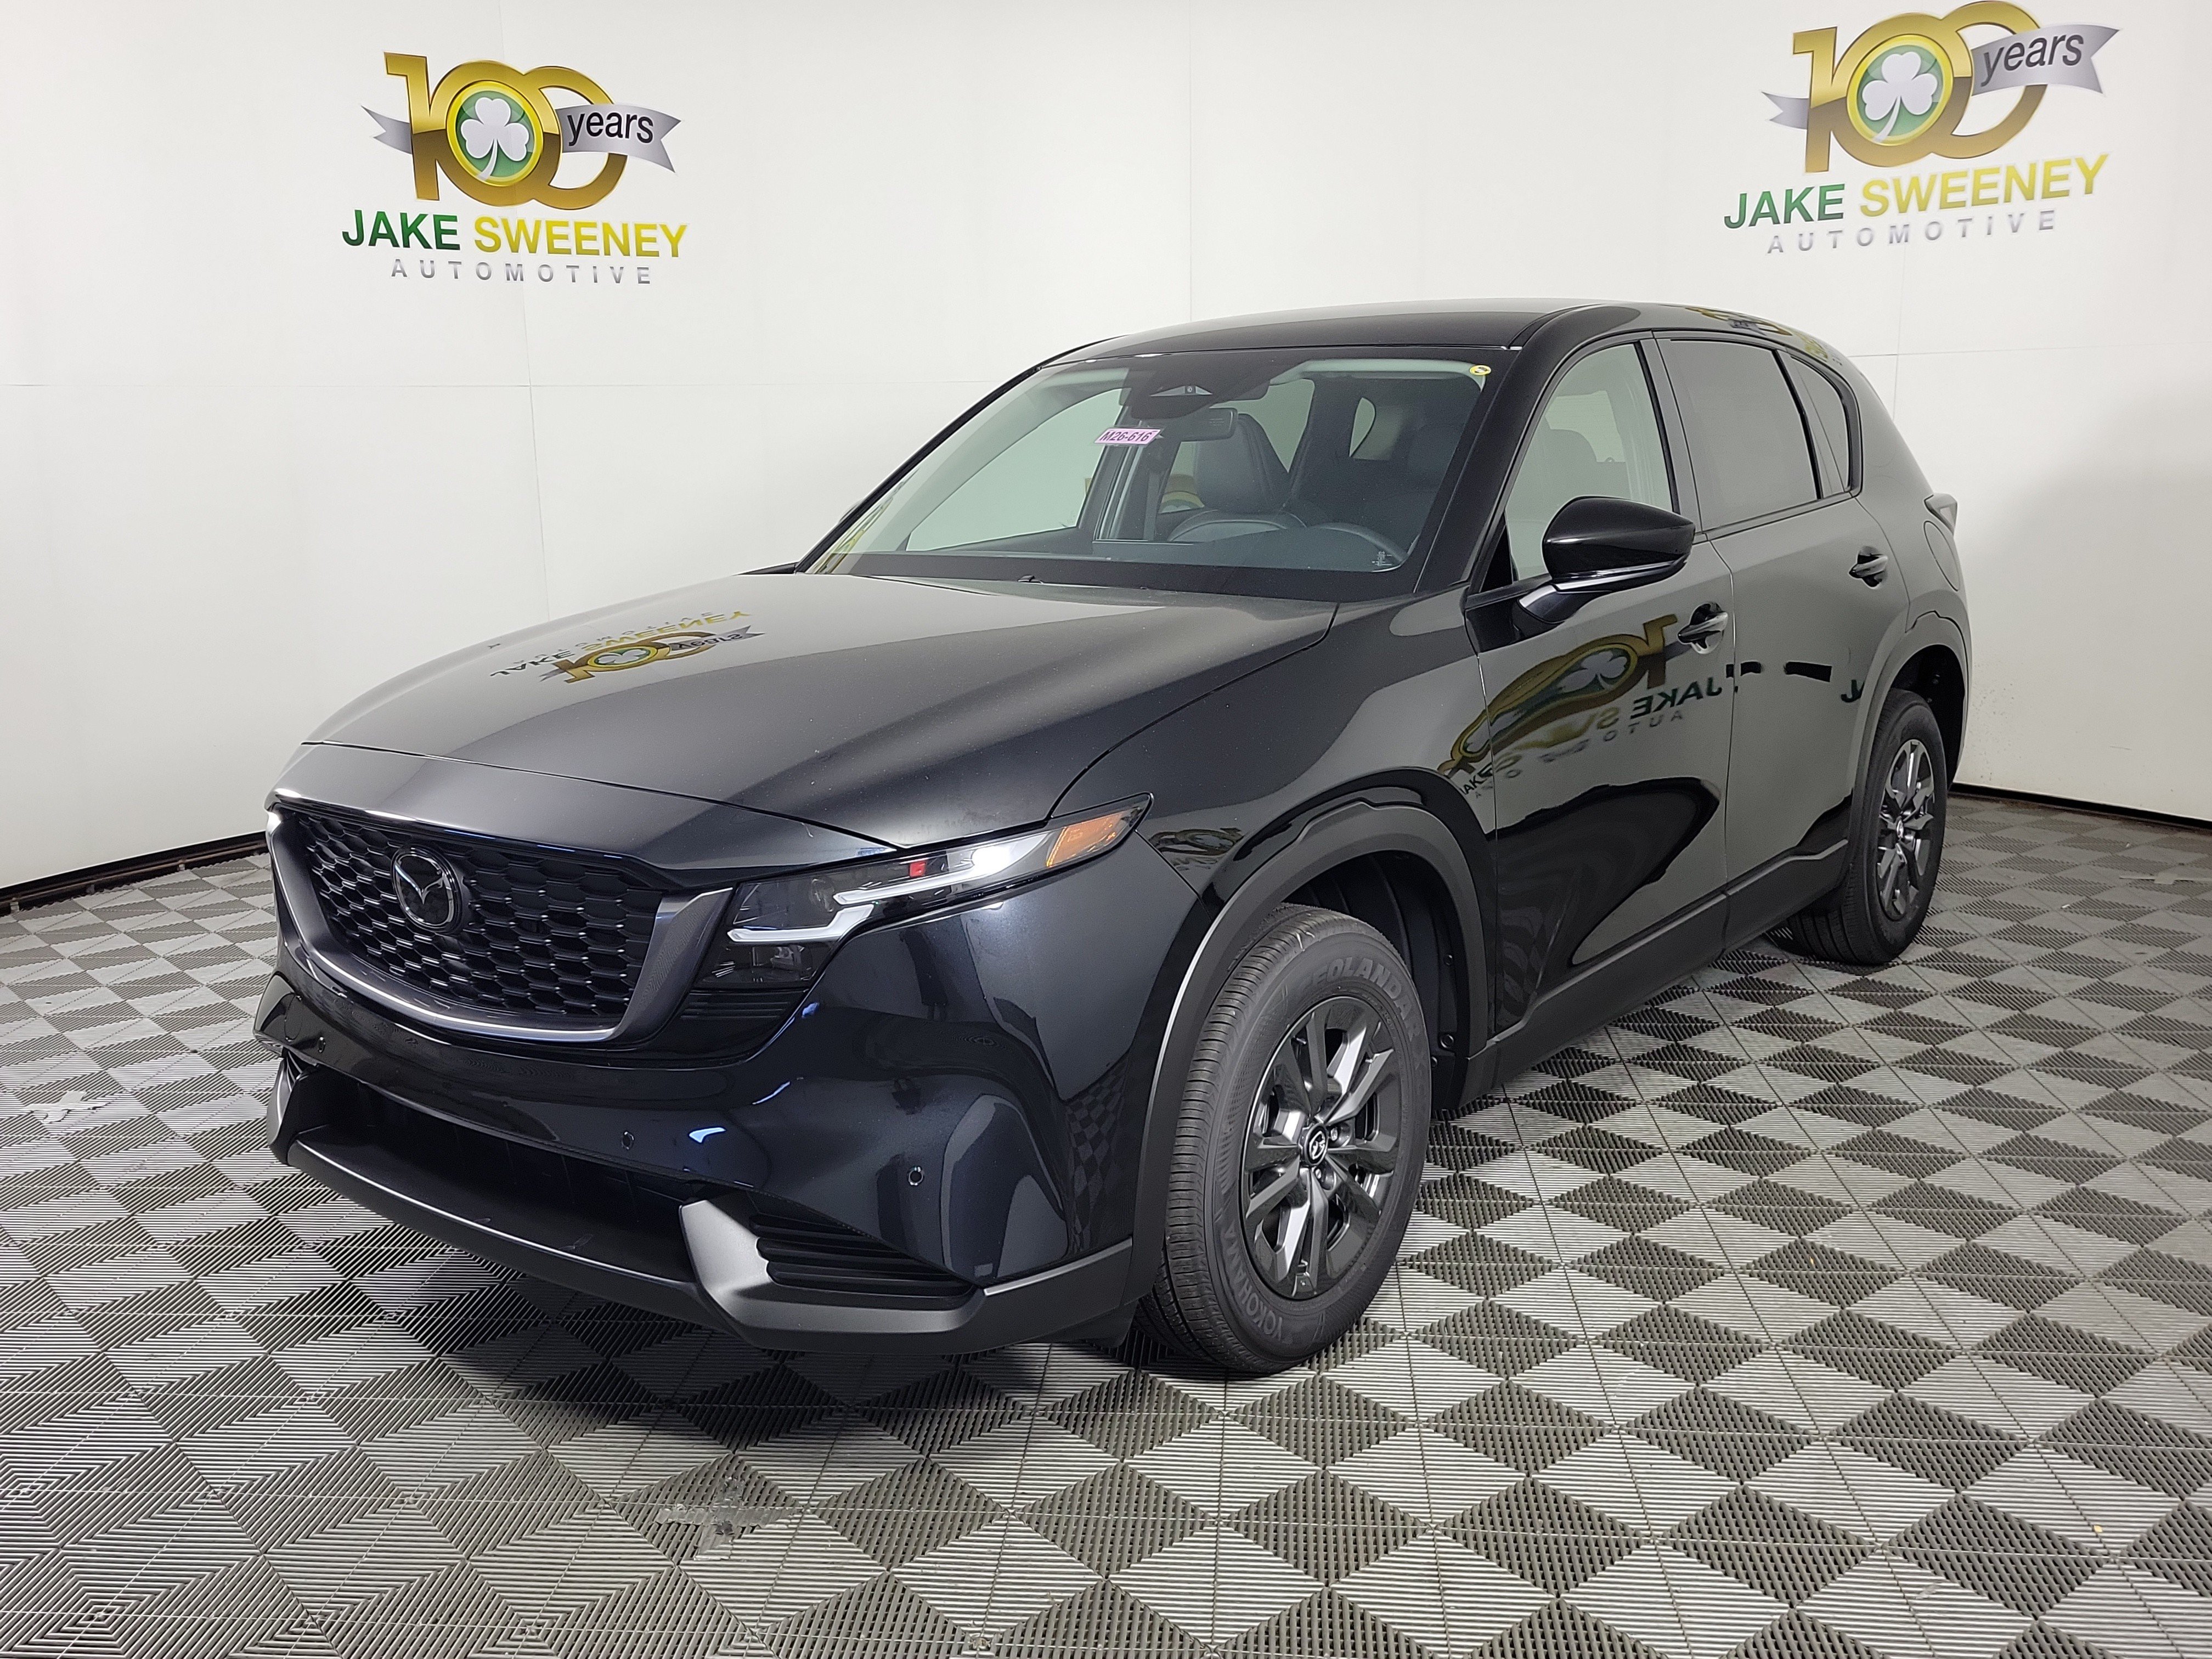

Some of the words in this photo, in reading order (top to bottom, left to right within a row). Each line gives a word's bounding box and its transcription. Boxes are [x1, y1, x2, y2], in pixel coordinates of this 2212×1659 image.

[1980, 33, 2084, 87] years
[567, 111, 654, 146] years
[1724, 184, 1845, 229] JAKE
[1860, 154, 2109, 218] SWEENEY
[342, 210, 461, 251] JAKE
[473, 216, 687, 257] SWEENEY
[1767, 210, 2055, 254] AUTOMOTIVE
[391, 258, 651, 284] AUTOMOTIVE
[1099, 431, 1153, 442] M26-616
[1223, 1218, 1284, 1341] YOKOHAMA
